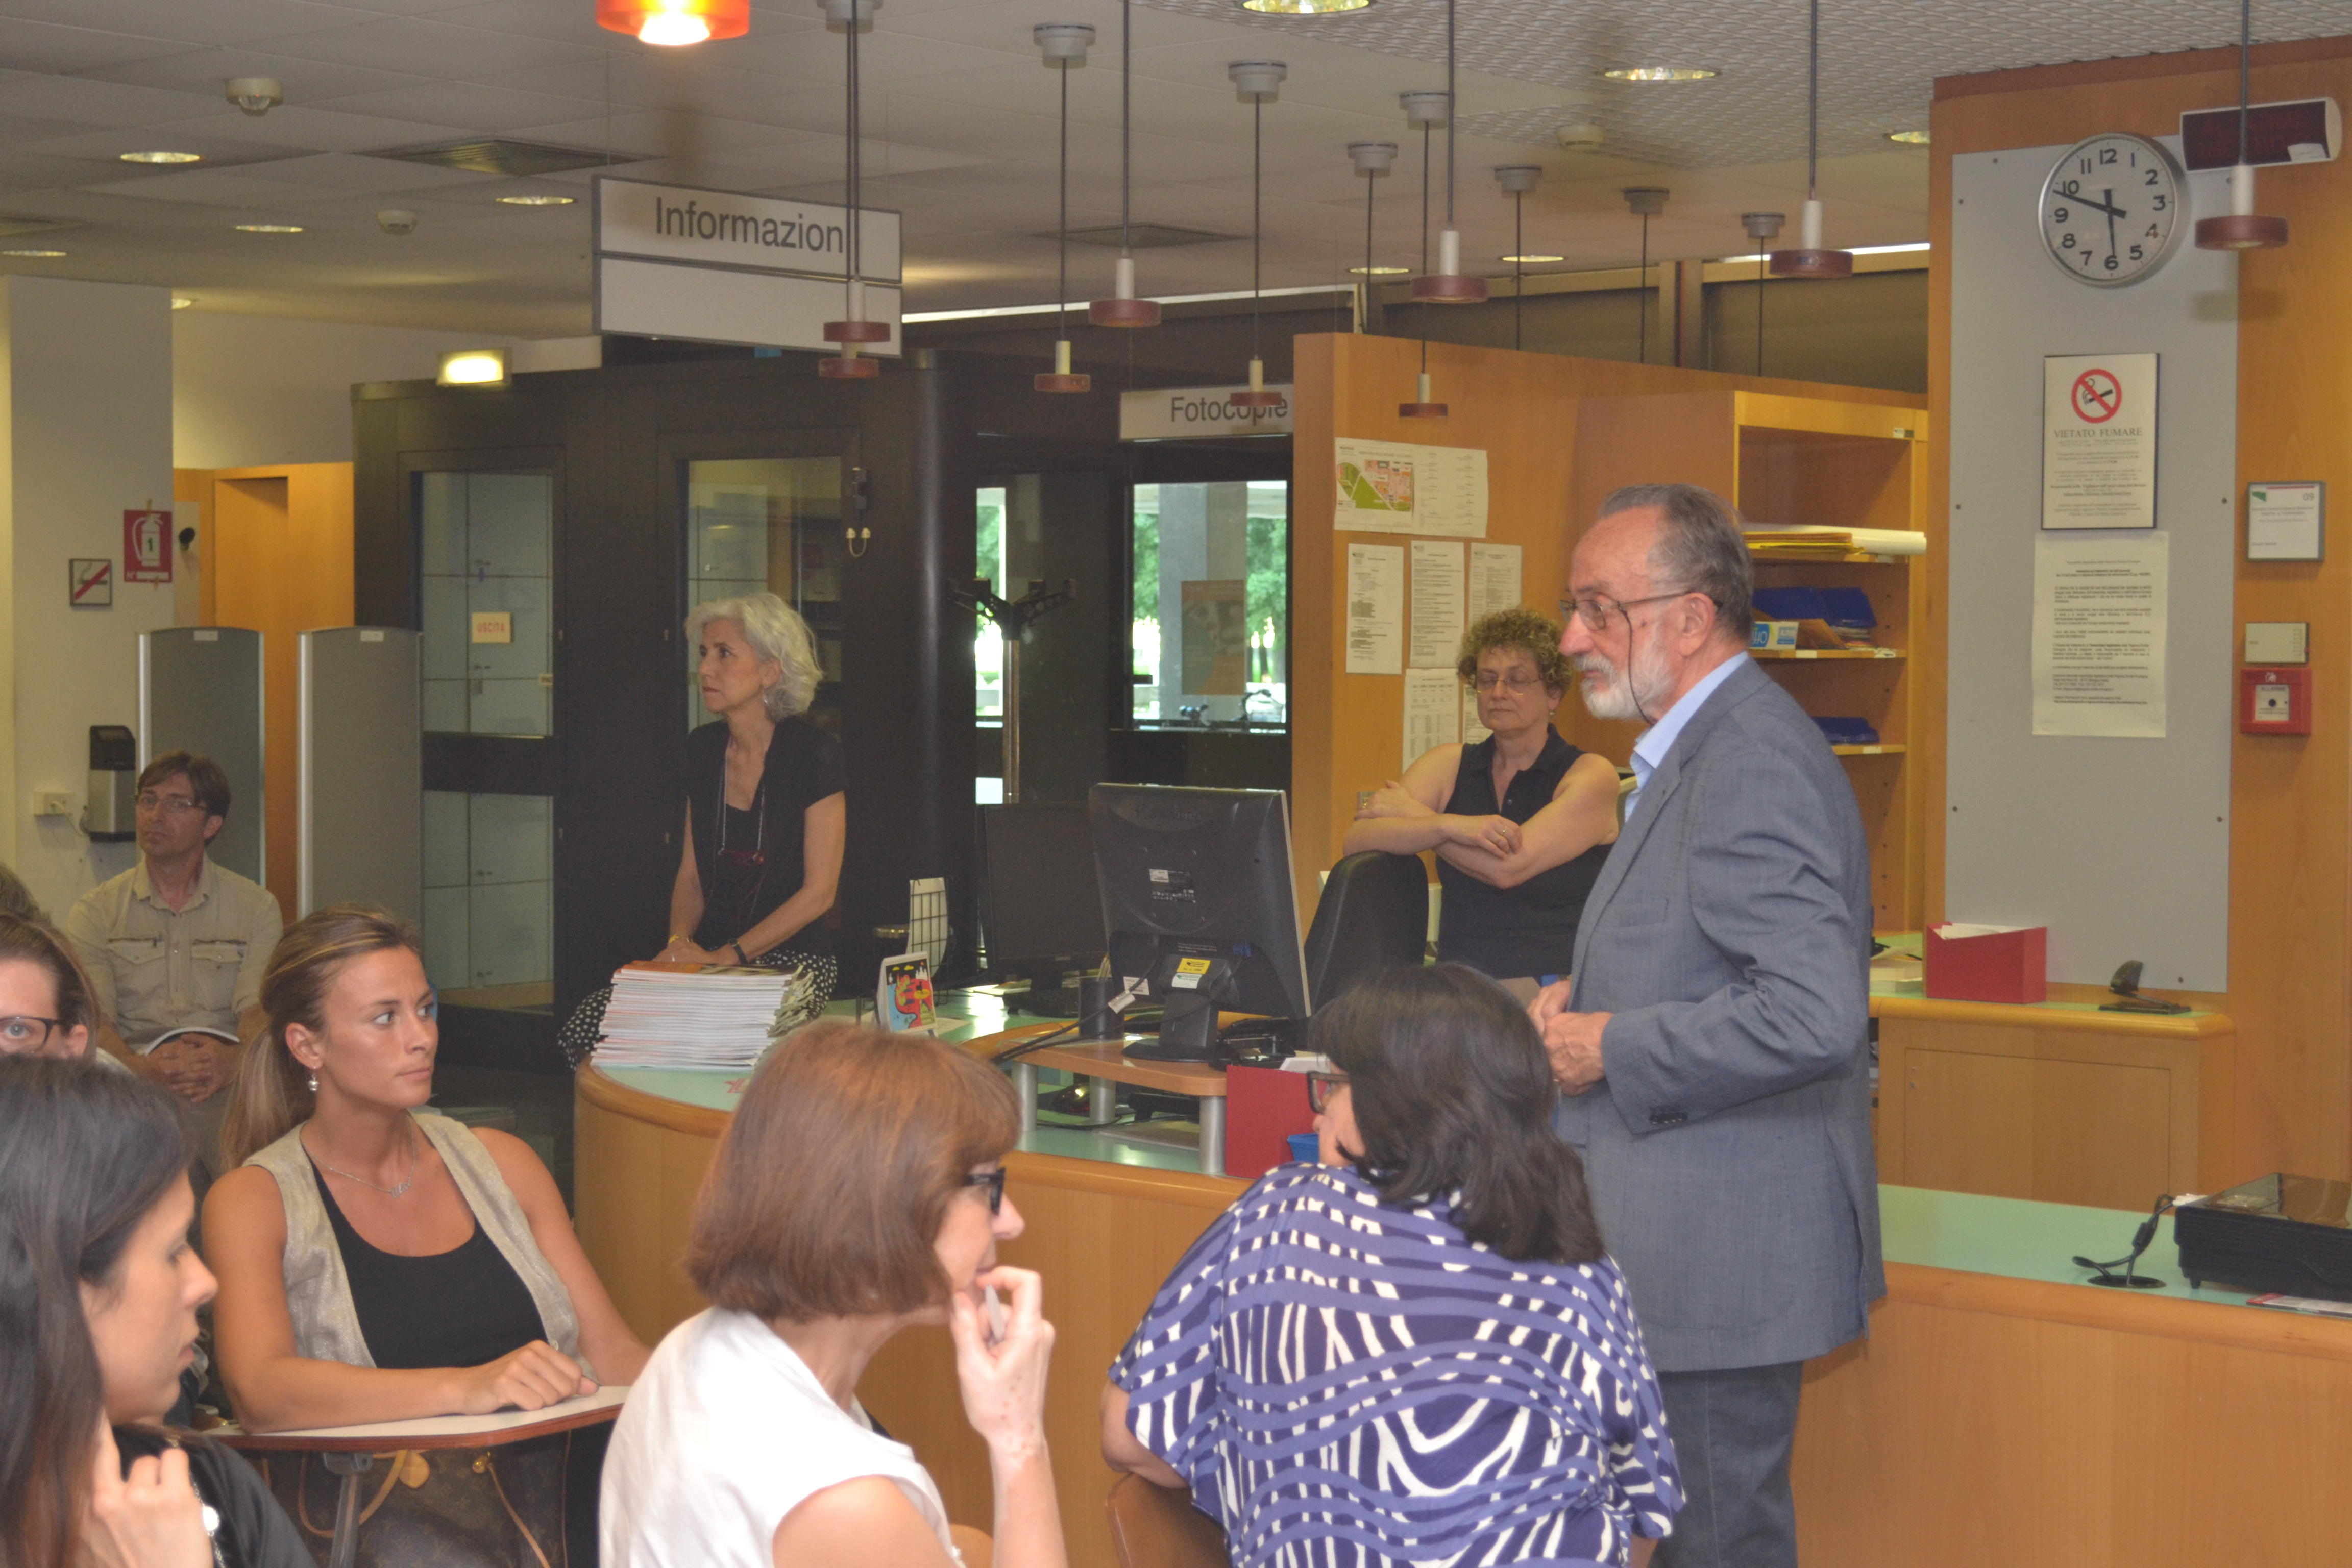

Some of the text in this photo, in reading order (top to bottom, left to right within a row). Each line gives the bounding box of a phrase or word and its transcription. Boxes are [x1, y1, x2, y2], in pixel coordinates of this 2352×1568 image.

[2100, 148, 2117, 164] 12
[2131, 153, 2135, 167] 1
[2080, 158, 2091, 174] 11
[2145, 169, 2158, 185] 2
[2063, 180, 2079, 194] 10
[2152, 195, 2166, 211] 3
[2054, 208, 2068, 223] 9
[656, 197, 844, 253] Informazion
[2145, 223, 2158, 238] 4
[2062, 233, 2075, 248] 8
[2080, 251, 2092, 265] 7
[2129, 245, 2143, 260] 5
[2104, 255, 2118, 270] 6
[2053, 427, 2143, 438] VIETATO FUMARE
[2302, 492, 2315, 501] 09
[148, 537, 153, 552] 1
